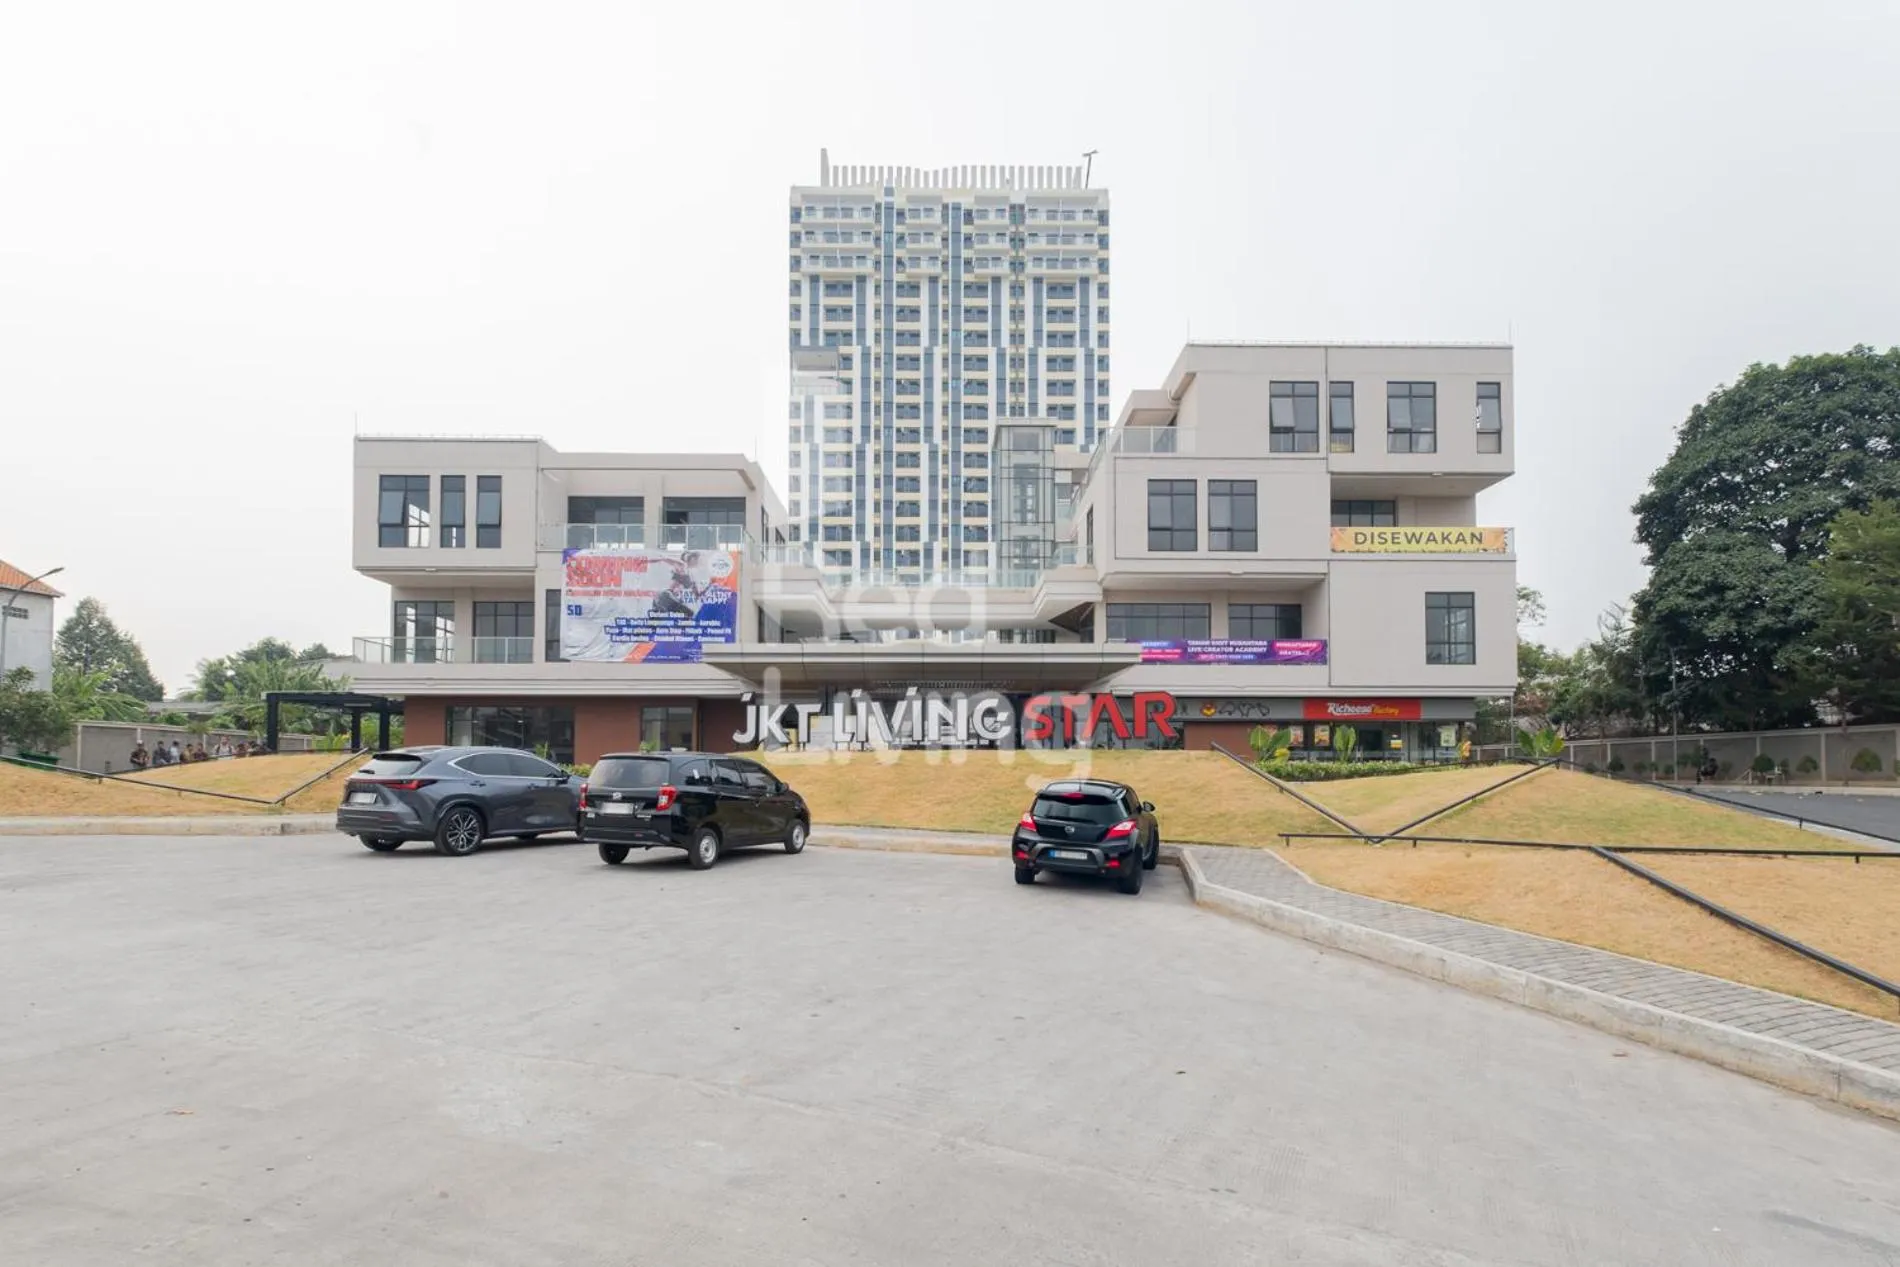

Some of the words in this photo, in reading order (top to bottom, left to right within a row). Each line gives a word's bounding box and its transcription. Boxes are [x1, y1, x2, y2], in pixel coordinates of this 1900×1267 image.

[1354, 531, 1483, 545] DISEWAKAN
[732, 692, 822, 744] JKT
[1023, 691, 1178, 740] STAR
